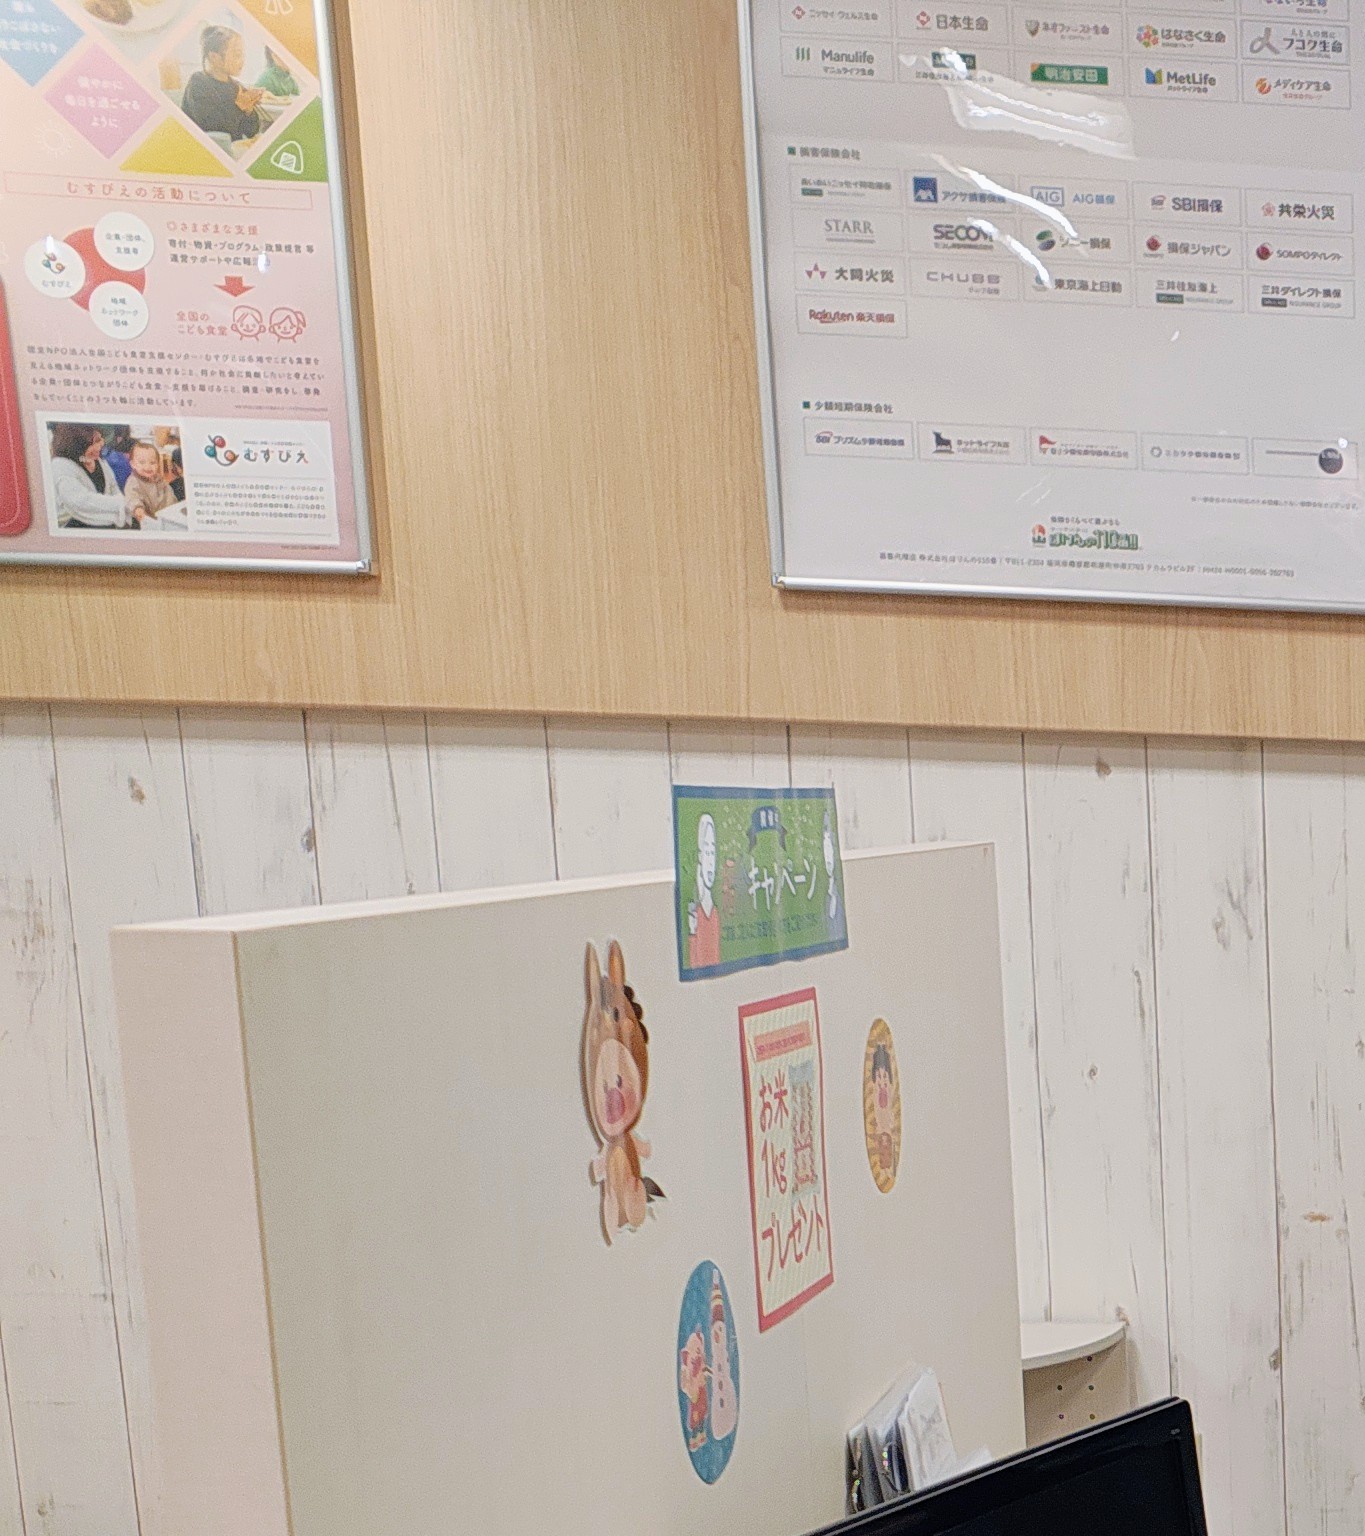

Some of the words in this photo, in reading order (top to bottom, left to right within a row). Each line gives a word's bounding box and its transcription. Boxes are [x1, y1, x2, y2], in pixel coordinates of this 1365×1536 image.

[936, 14, 989, 31] 日本生命
[1161, 28, 1226, 43] はなさく生命
[1283, 37, 1343, 53] フコク生命
[821, 48, 875, 64] Manulife
[1166, 71, 1216, 87] MetLife
[67, 182, 251, 203] むすびえの活動について
[1034, 191, 1061, 203] AIG
[1172, 197, 1223, 214] SBI損保
[1279, 203, 1335, 221] 共栄火災
[824, 219, 874, 234] STARR
[1167, 241, 1232, 258] 損保ジャパン
[926, 271, 1000, 284] CHUBB
[808, 308, 855, 324] Rakuten
[243, 447, 310, 466] むすびえ
[758, 1067, 790, 1134] お米
[760, 1138, 787, 1198] 1kg
[761, 1193, 824, 1282] プレゼント
